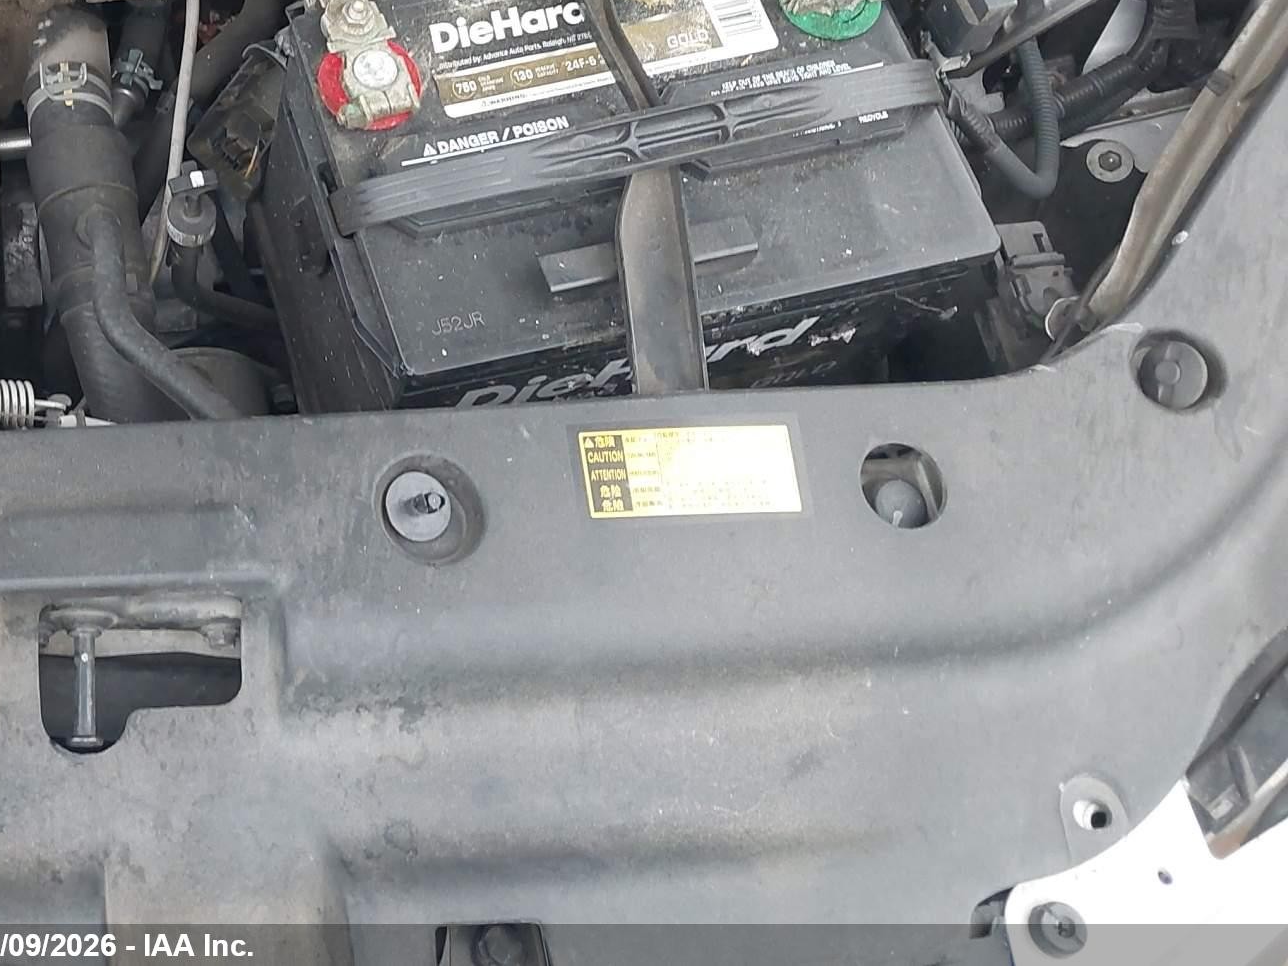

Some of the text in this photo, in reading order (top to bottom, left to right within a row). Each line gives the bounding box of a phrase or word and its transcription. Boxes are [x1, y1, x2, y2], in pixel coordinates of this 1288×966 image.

[437, 115, 570, 155] DANGER / POISON
[431, 311, 486, 336] J52JR
[587, 449, 624, 463] CAUTION
[591, 468, 627, 482] ATTENTION
